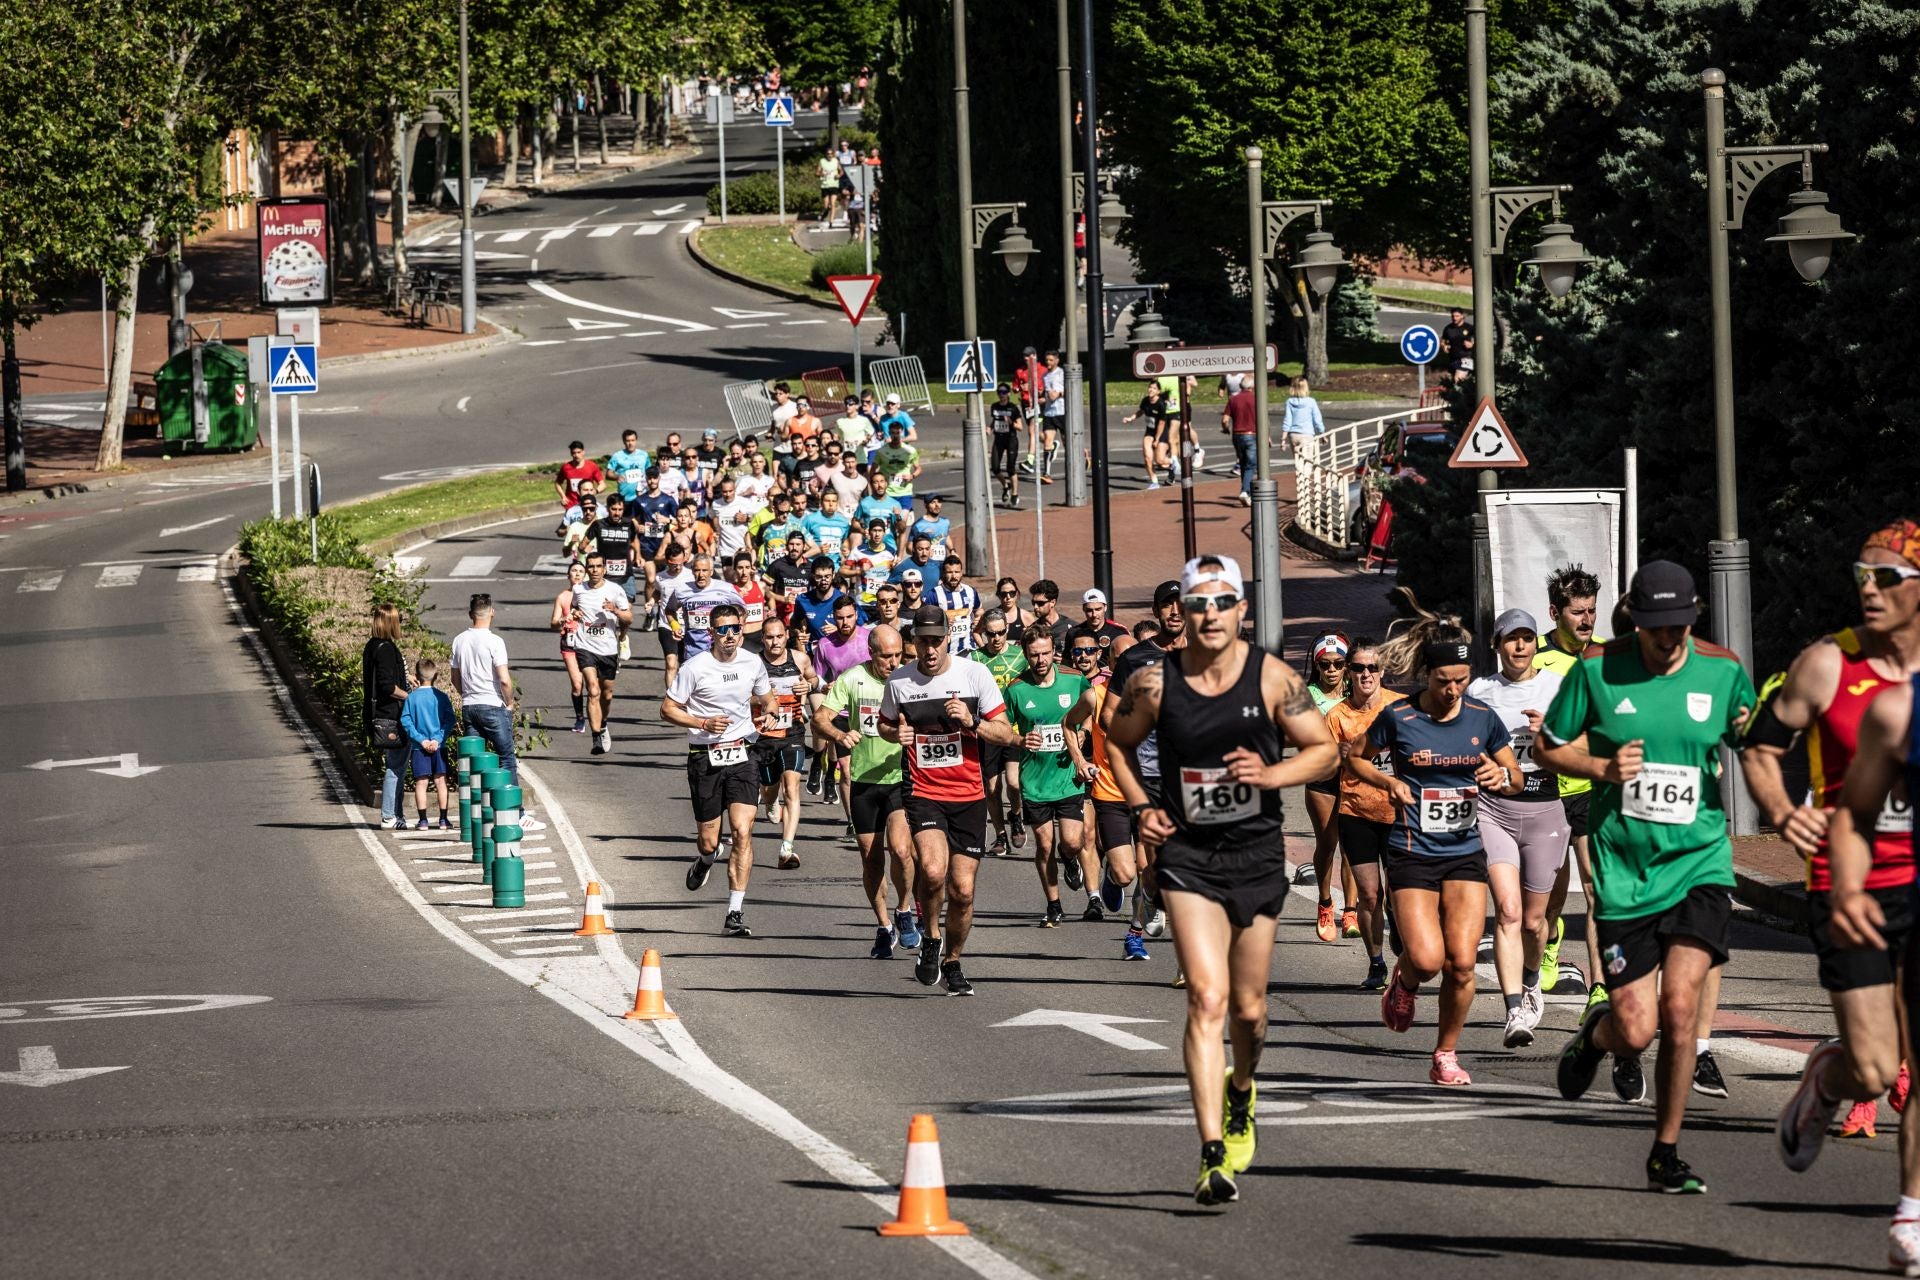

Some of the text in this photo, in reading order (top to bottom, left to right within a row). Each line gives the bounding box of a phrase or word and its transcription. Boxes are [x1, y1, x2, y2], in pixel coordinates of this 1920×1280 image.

[264, 224, 321, 237] McFlurry
[608, 564, 626, 572] 522
[694, 615, 708, 625] 95
[586, 627, 605, 636] 406
[713, 746, 741, 761] 377
[921, 743, 958, 760] 399
[1191, 783, 1252, 810] 160
[1629, 780, 1695, 805] 1164
[1428, 800, 1473, 821] 539
